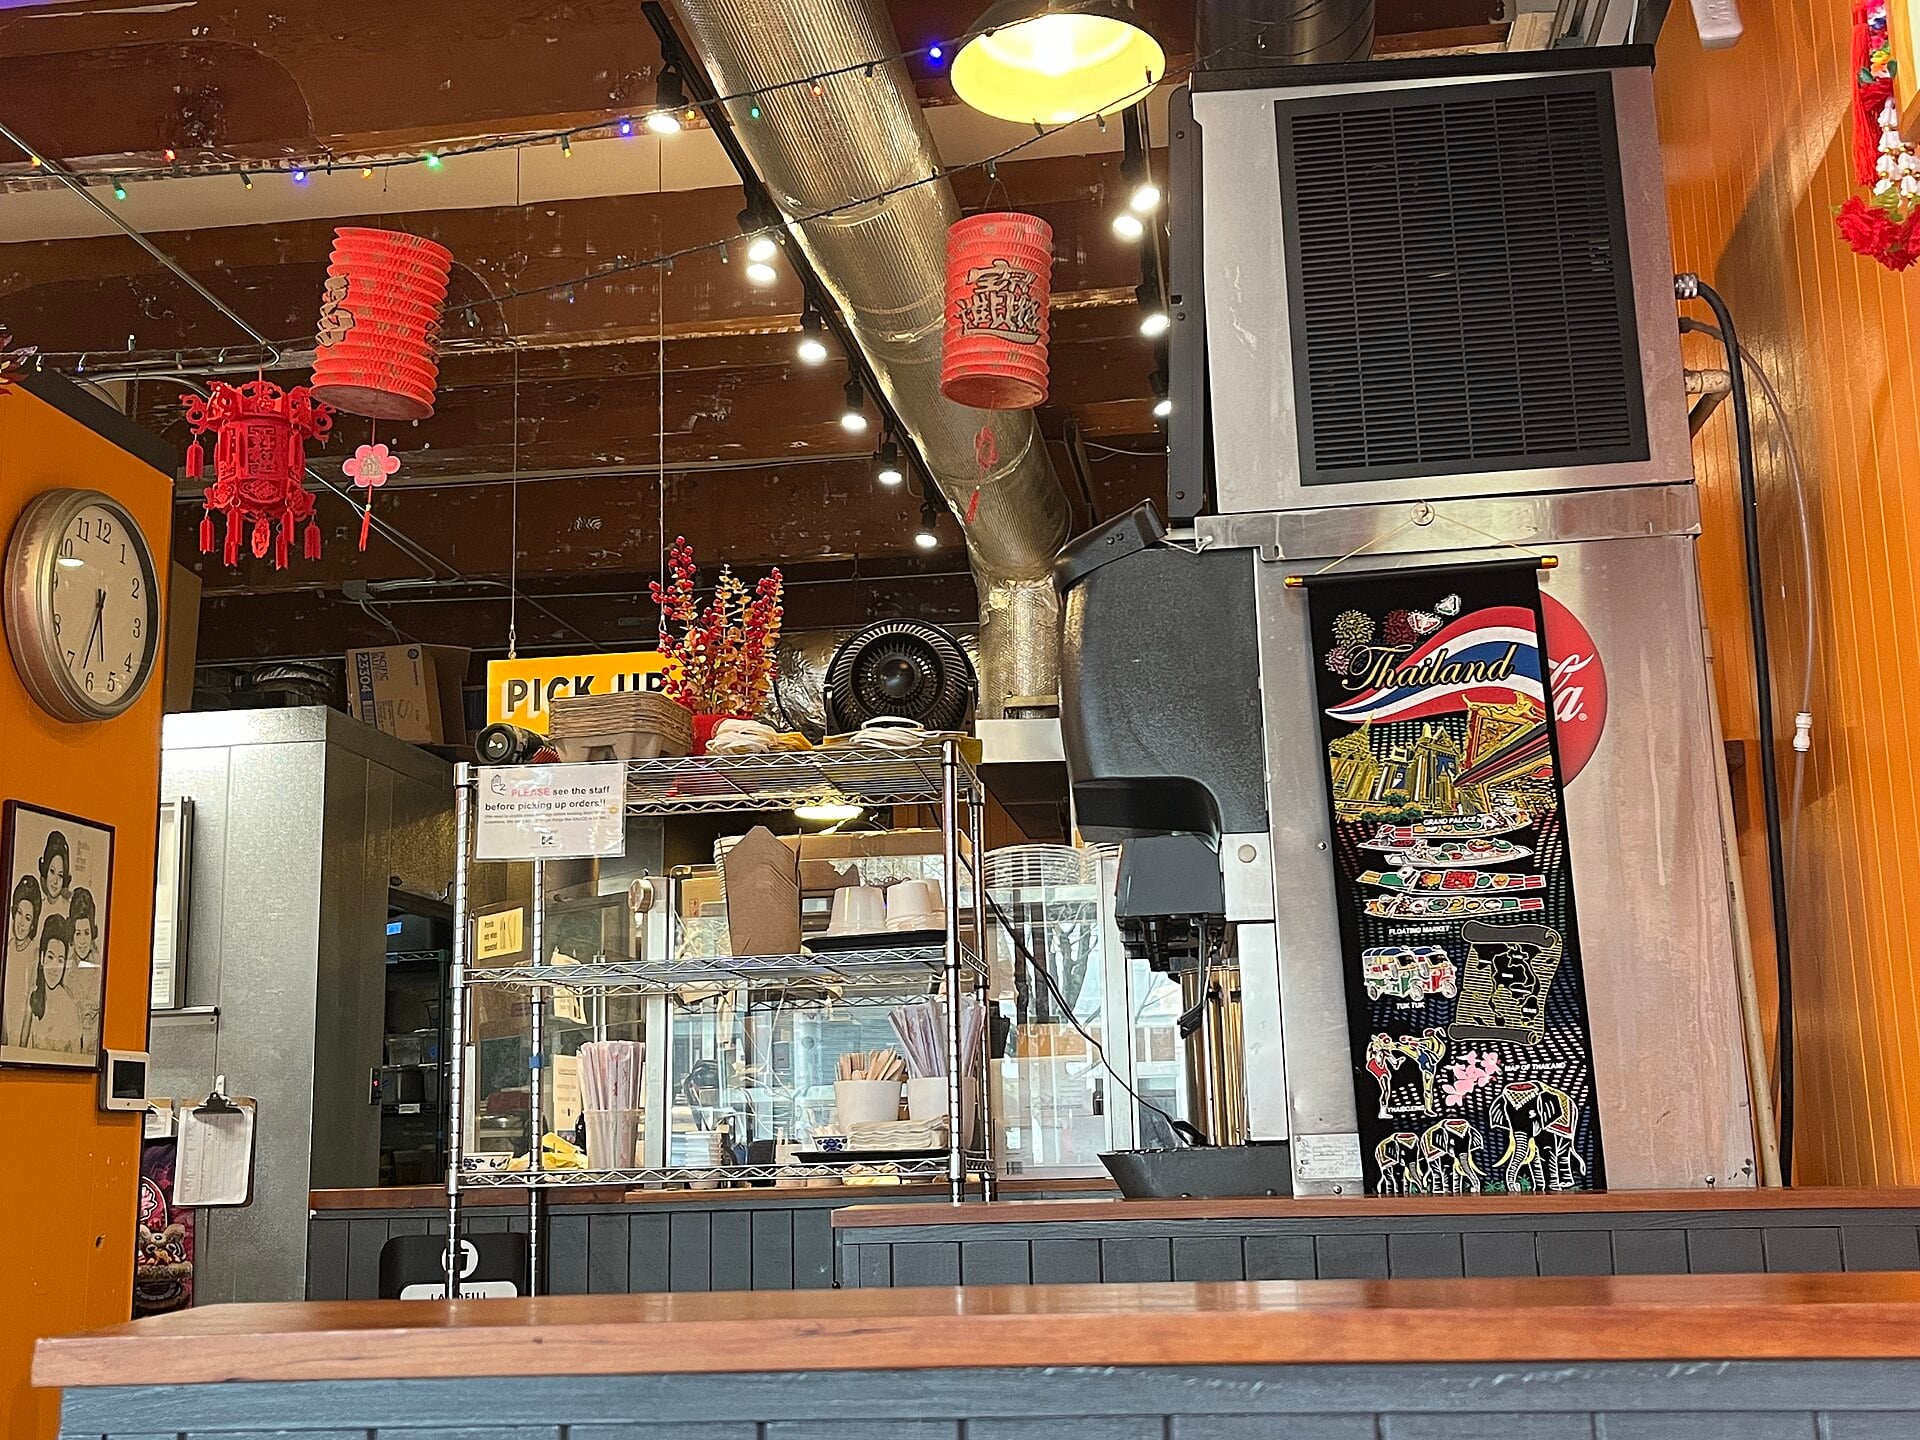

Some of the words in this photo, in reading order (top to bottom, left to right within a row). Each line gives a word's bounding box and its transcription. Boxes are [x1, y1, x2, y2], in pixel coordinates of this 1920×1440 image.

[76, 517, 90, 543] 11
[96, 518, 112, 544] 12
[119, 544, 126, 565] 1
[131, 578, 140, 600] 2
[133, 617, 141, 639] 3
[66, 650, 75, 669] 7
[124, 652, 133, 673] 4
[1342, 643, 1517, 691] Thailand
[85, 671, 94, 693] 6
[107, 671, 116, 693] 5
[357, 654, 371, 693] 23304
[506, 675, 596, 714] PICK
[511, 787, 550, 797] PLEASE
[553, 788, 569, 796] see
[571, 786, 586, 795] the
[589, 785, 610, 794] staff
[485, 803, 515, 811] before
[518, 801, 552, 812] picking
[555, 802, 567, 810] up
[569, 799, 606, 808] orders!!
[1423, 817, 1448, 826] GRAND
[1449, 815, 1477, 824] PALACE
[1388, 926, 1421, 935] FLOATING
[1422, 925, 1450, 933] MARKET
[1396, 1002, 1411, 1010] TUK
[1411, 1001, 1426, 1009] TUK
[1504, 1064, 1520, 1072] MAP
[1520, 1063, 1530, 1071] OF
[1531, 1062, 1567, 1070] THAILAND
